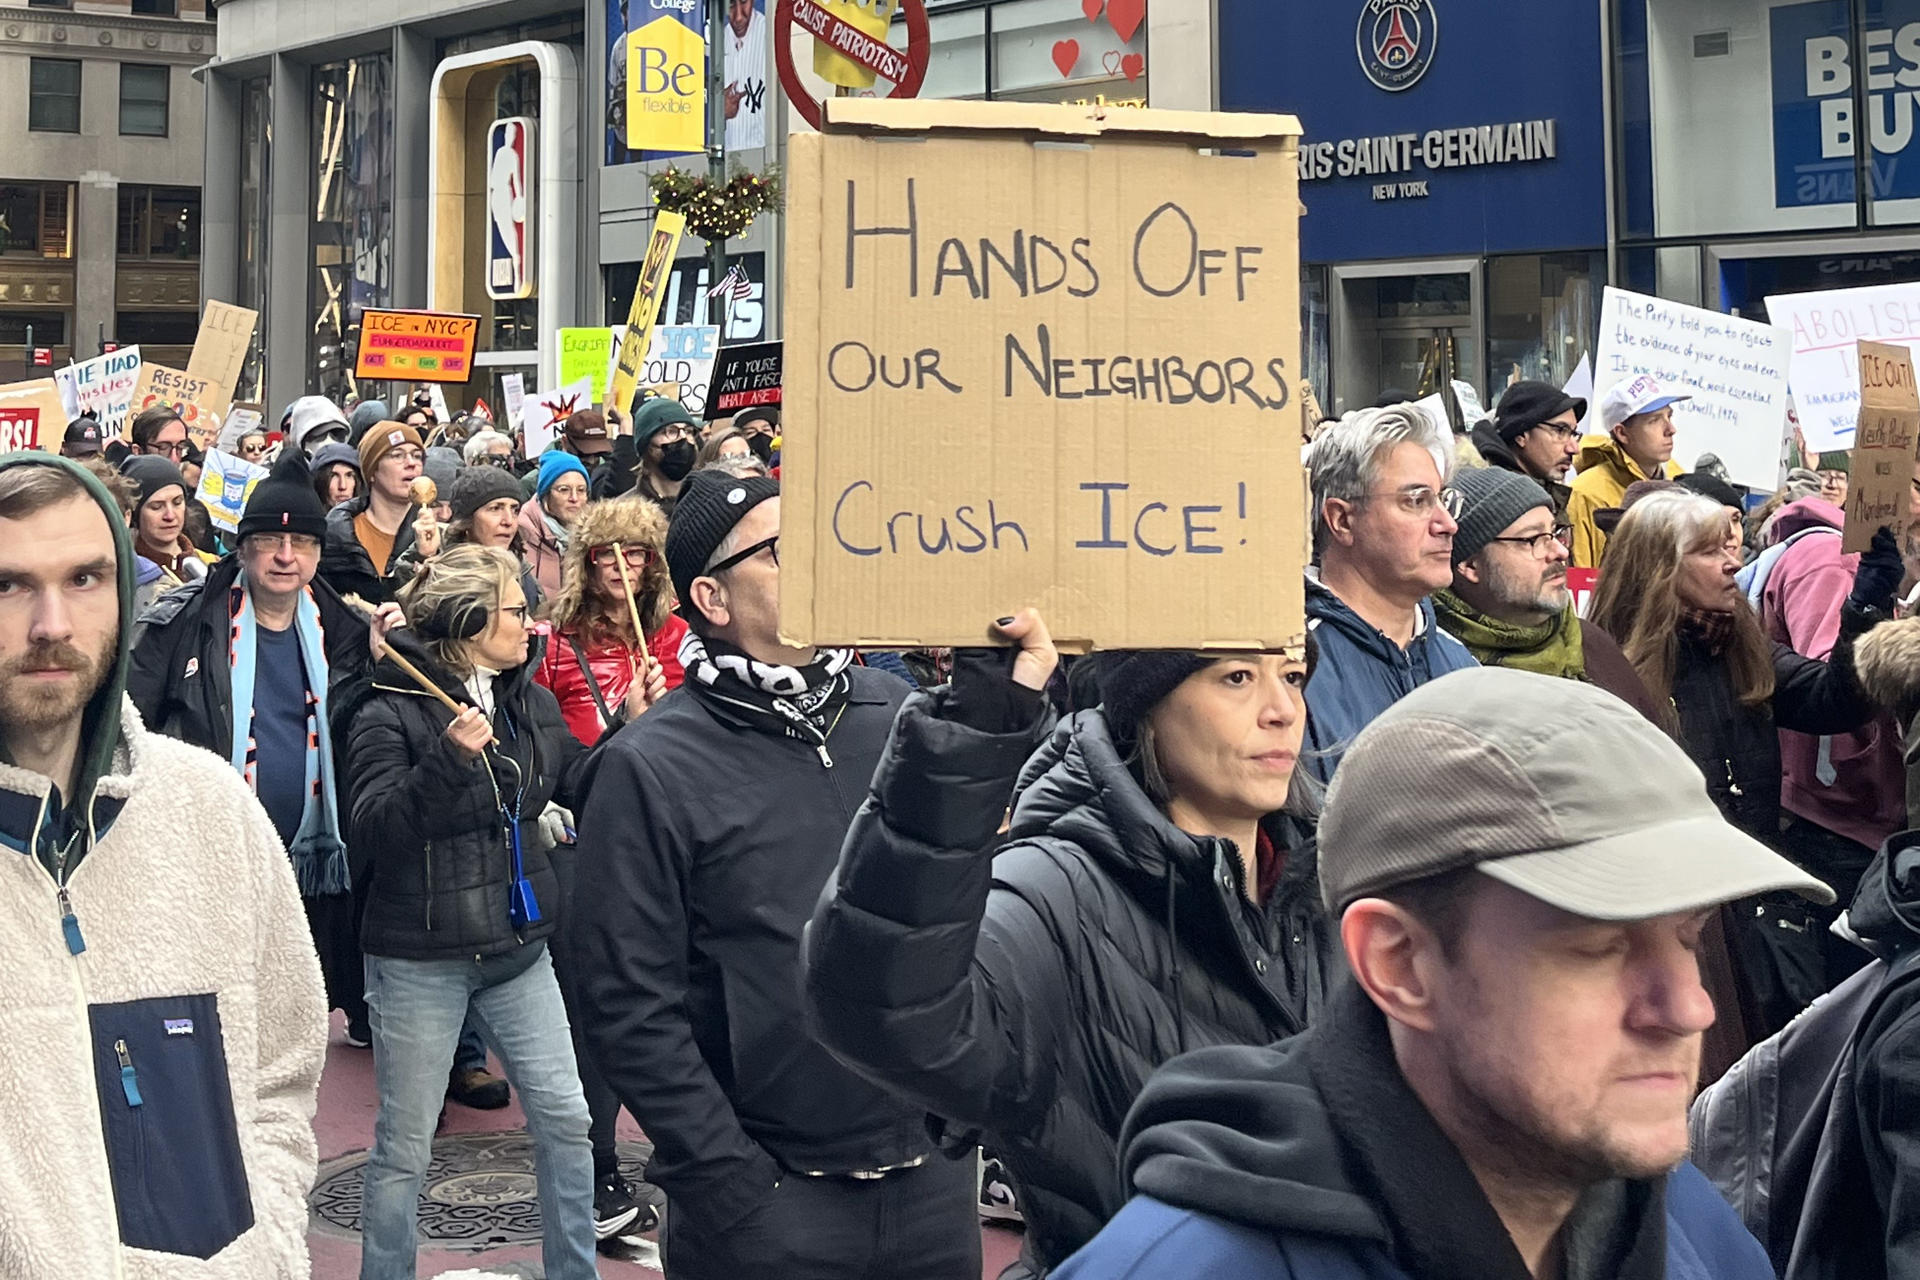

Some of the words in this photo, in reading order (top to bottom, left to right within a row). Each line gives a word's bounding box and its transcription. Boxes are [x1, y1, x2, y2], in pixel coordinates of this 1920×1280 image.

[830, 22, 908, 83] PATRIOTISM
[635, 46, 696, 97] Be
[643, 97, 692, 113] flexible
[1820, 91, 1920, 159] BU
[1337, 119, 1556, 177] SAINT-GERMAIN
[1372, 184, 1396, 200] NEW
[1398, 180, 1429, 198] YORK
[366, 315, 405, 331] ICE
[424, 319, 473, 335] NYC?
[1615, 296, 1642, 319] The
[1646, 303, 1675, 330] Party
[1680, 314, 1700, 331] told
[1704, 325, 1721, 338] you
[1724, 325, 1737, 338] to
[660, 326, 716, 359] ICE
[1616, 324, 1636, 346] the
[1640, 336, 1680, 354] evidence
[1683, 344, 1693, 356] of
[1695, 352, 1714, 364] your
[1718, 356, 1740, 369] eyes
[1743, 362, 1758, 373] and
[726, 361, 739, 376] IF
[1004, 324, 1289, 410] NEIGHBORS
[1610, 355, 1629, 372] It
[152, 369, 208, 393] RESIST
[721, 377, 748, 393] ANTI
[719, 392, 745, 410] WHAT
[751, 391, 770, 404] ARE
[832, 481, 1028, 555] Crush
[1075, 482, 1248, 556] ICE!
